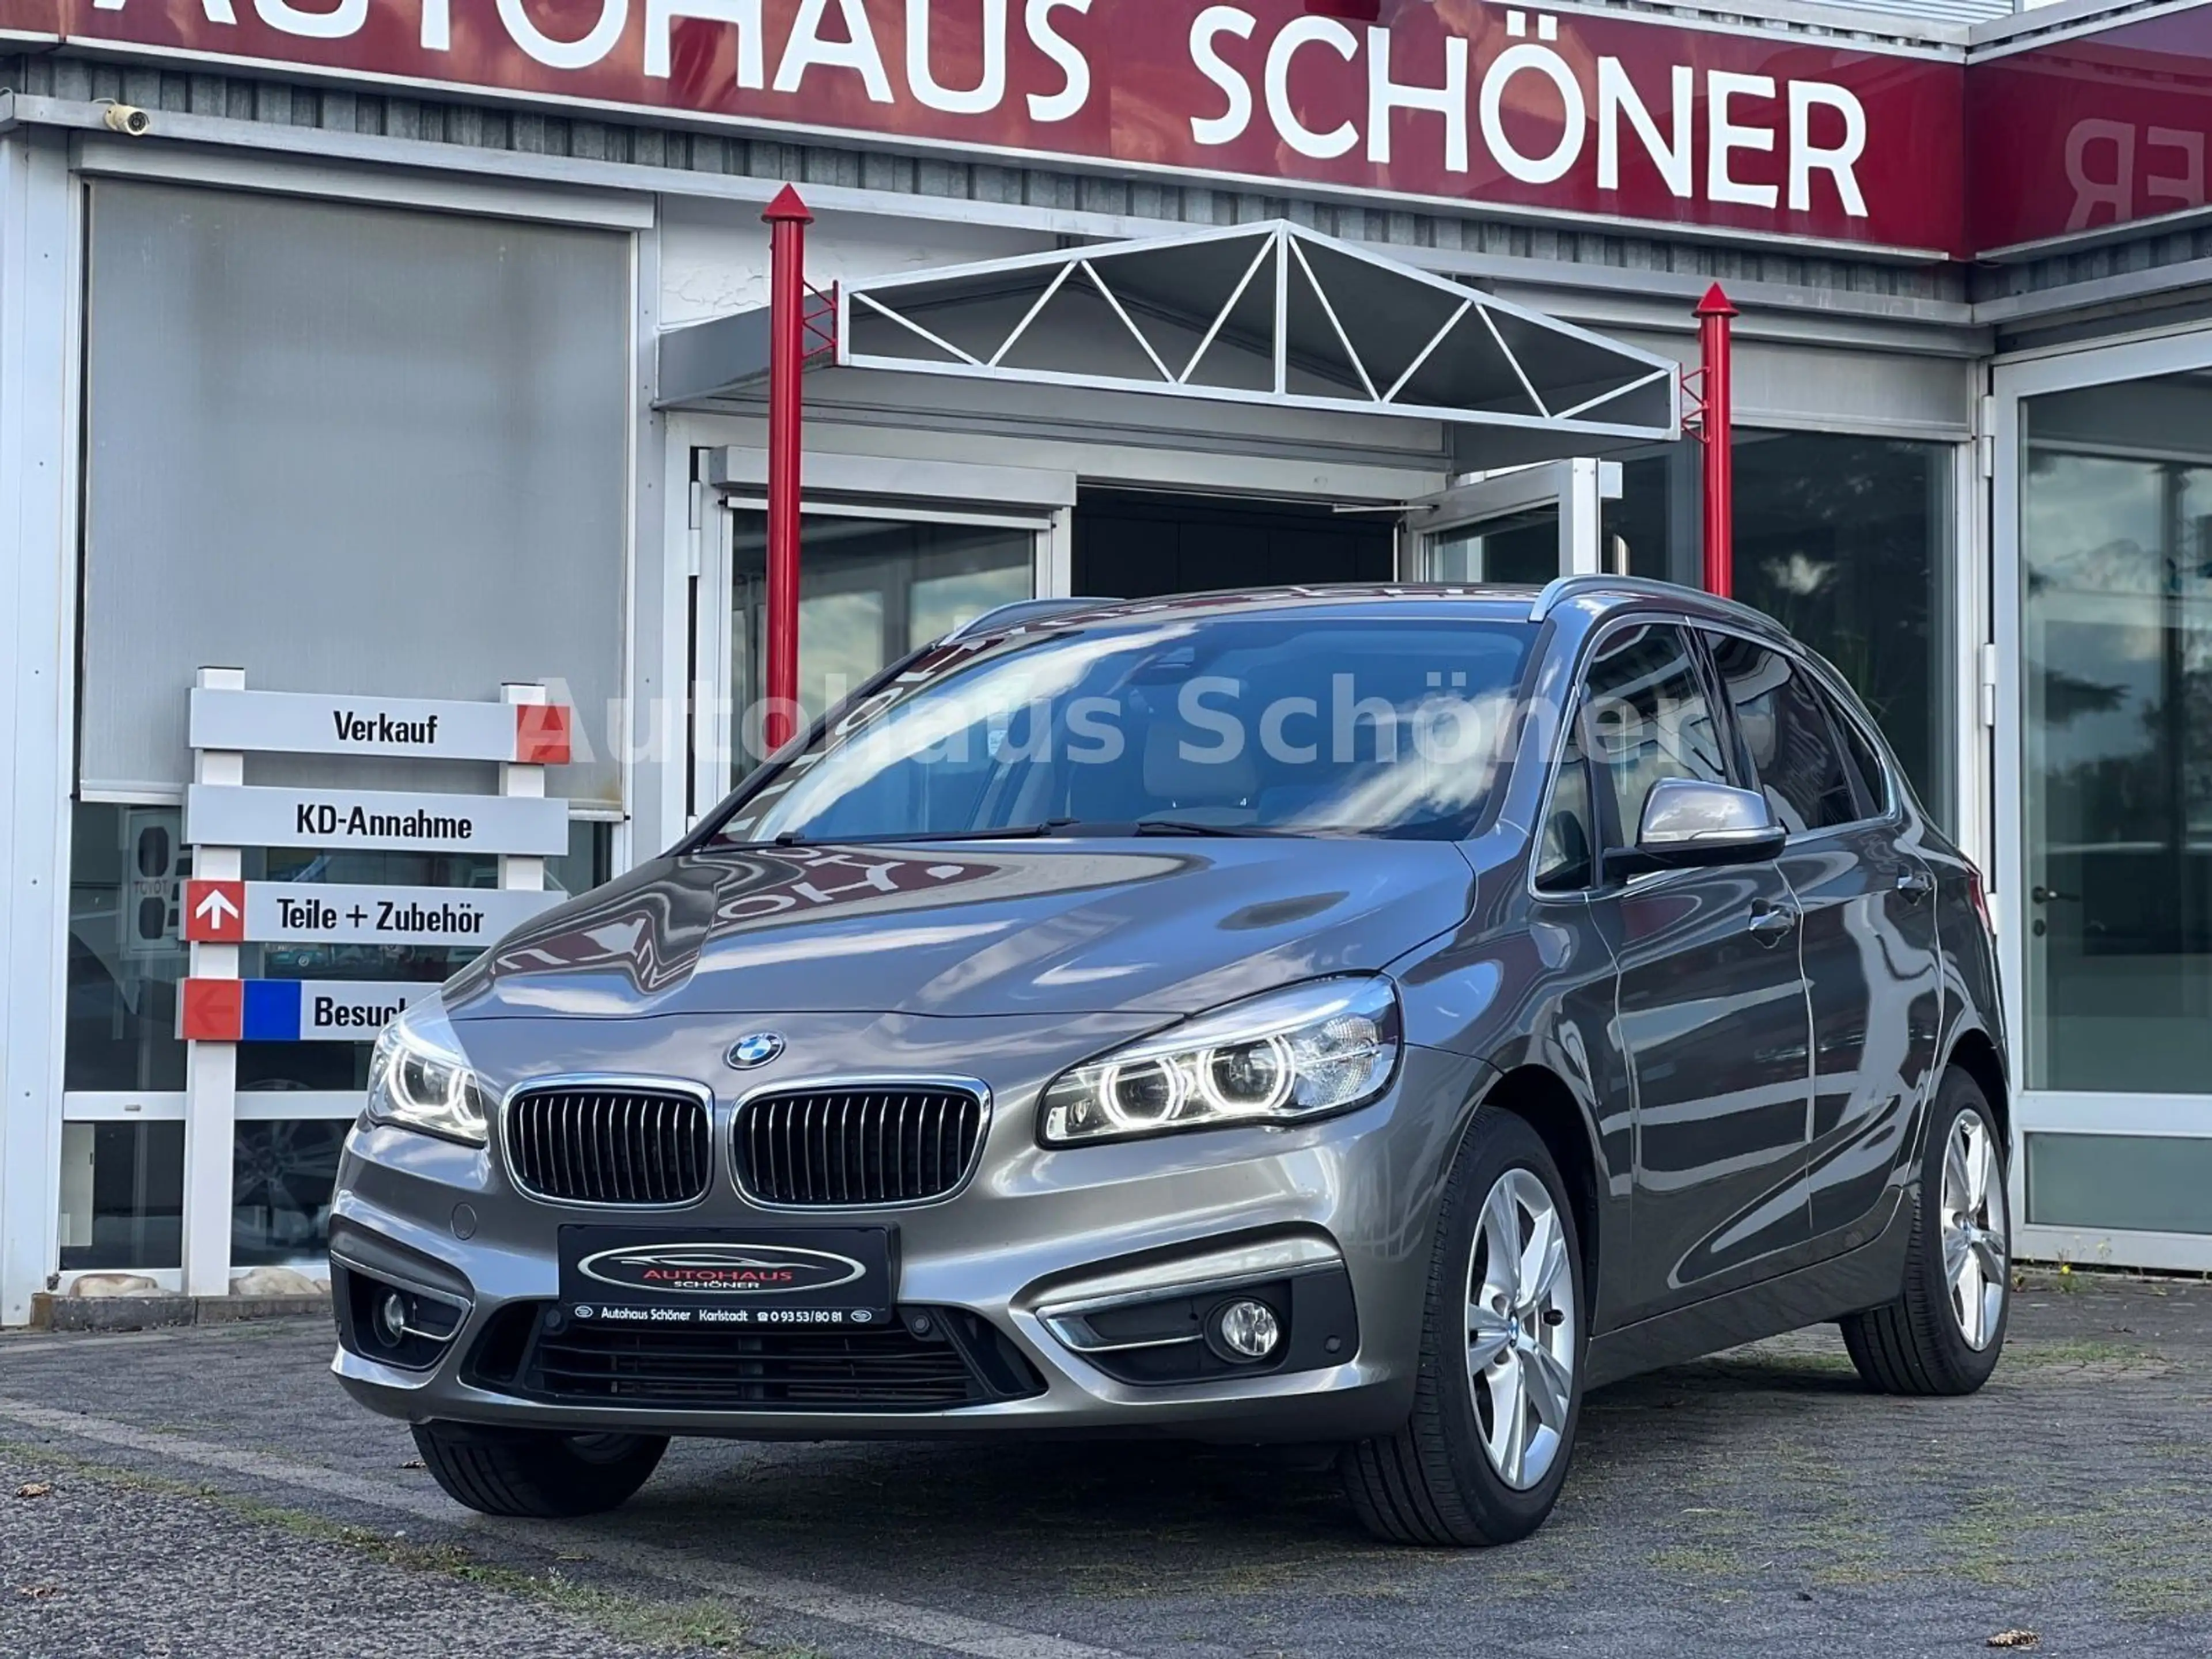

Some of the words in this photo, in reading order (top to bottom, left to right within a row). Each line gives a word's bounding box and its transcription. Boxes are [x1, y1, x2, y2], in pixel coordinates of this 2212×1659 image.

[1190, 5, 1867, 217] SCHÖNER
[334, 710, 438, 744] Verkauf
[296, 804, 472, 839] KD-Annahme
[276, 899, 337, 929] Teile
[376, 901, 484, 933] Zubehör
[643, 1270, 793, 1281] AUTOHAUS
[673, 1280, 760, 1289] SCHÖNER
[600, 1306, 648, 1320] Autohaus
[650, 1308, 691, 1321] Schöner
[699, 1309, 749, 1322] Karlstadt
